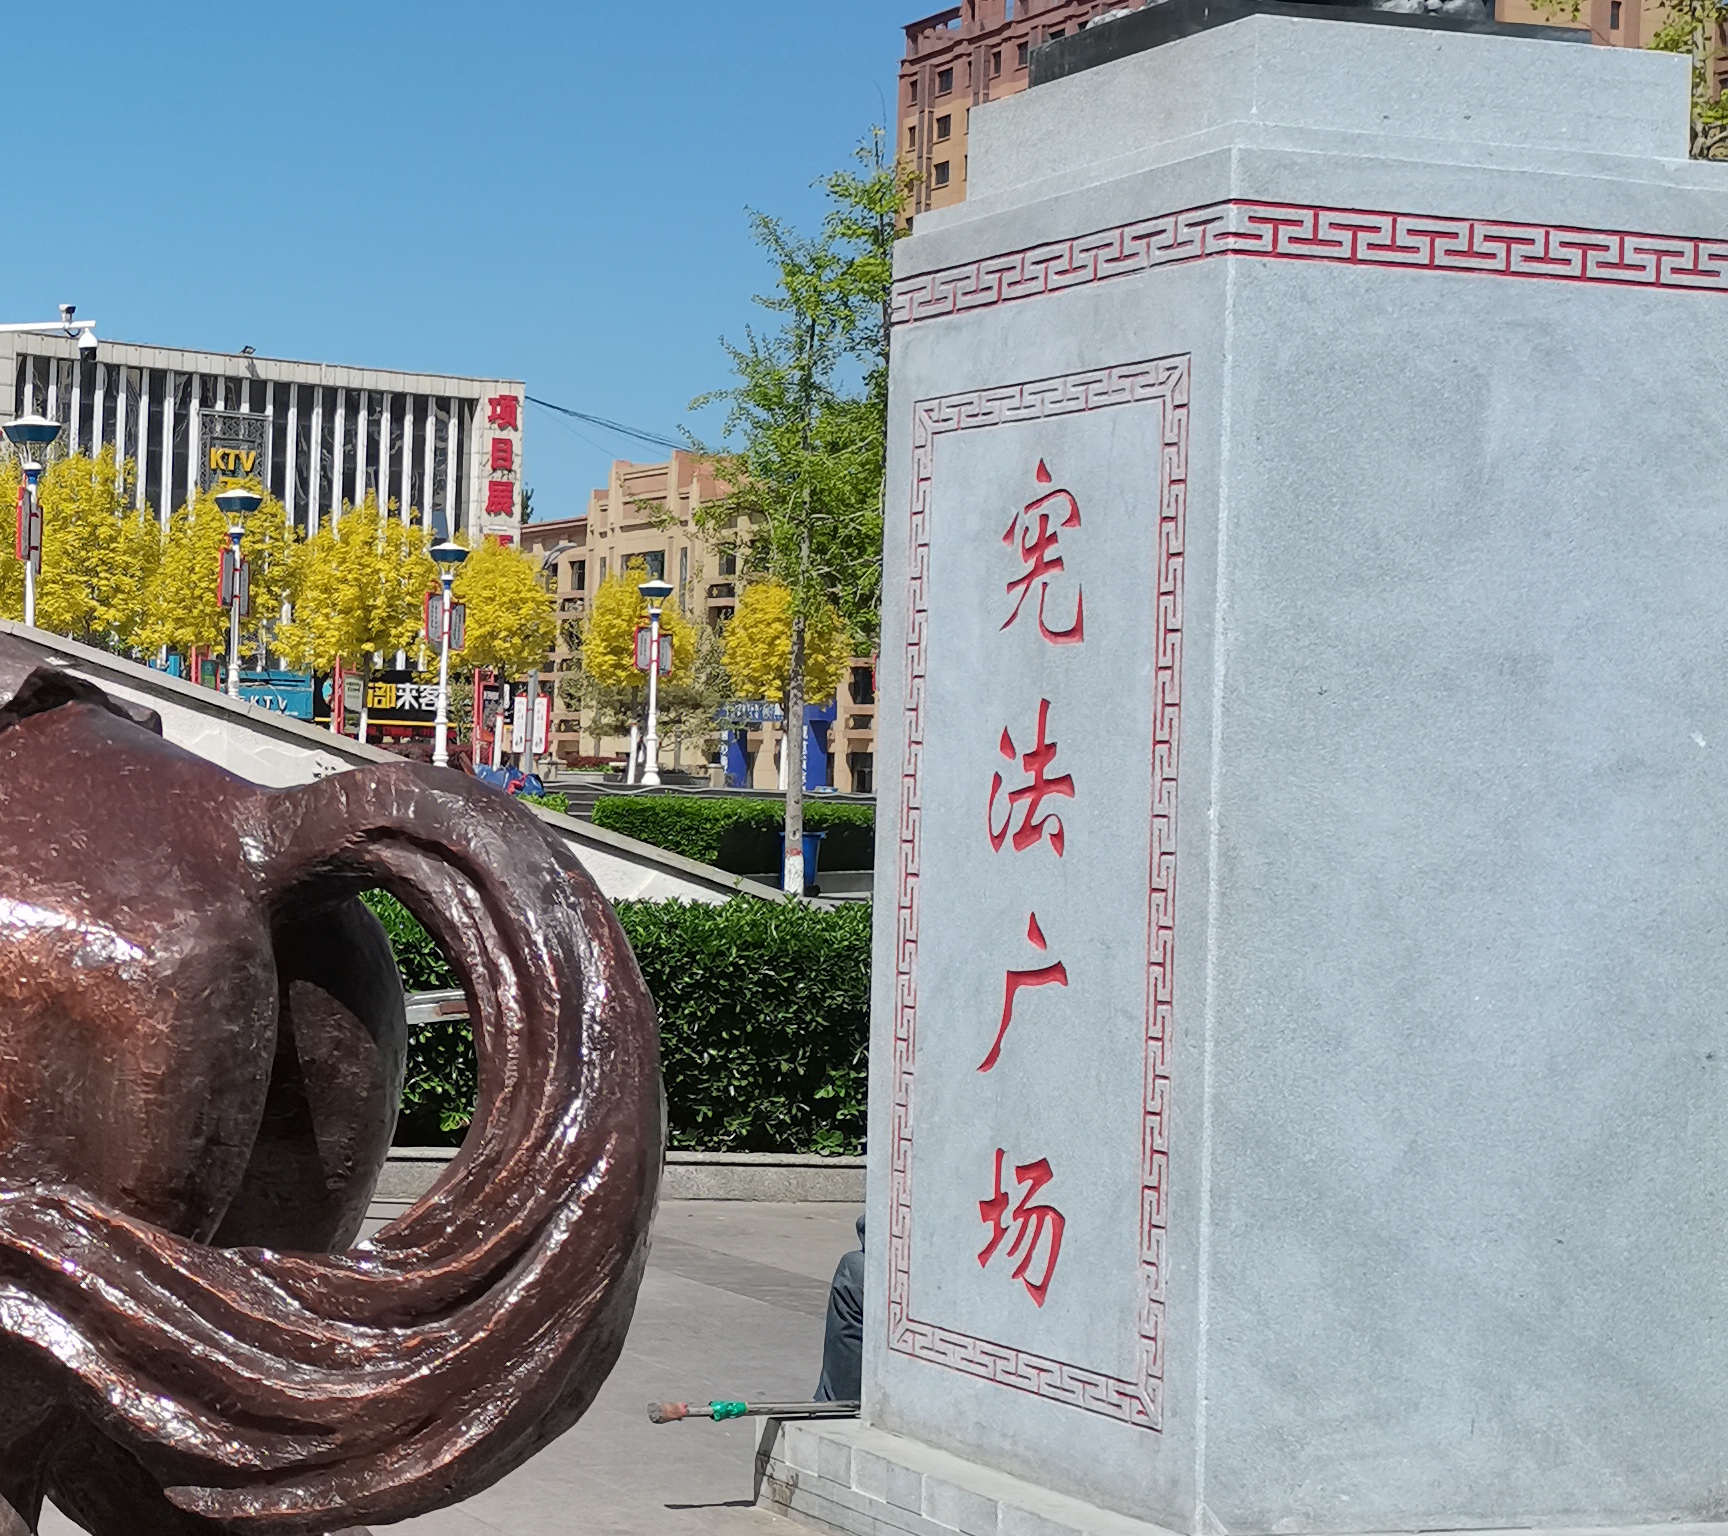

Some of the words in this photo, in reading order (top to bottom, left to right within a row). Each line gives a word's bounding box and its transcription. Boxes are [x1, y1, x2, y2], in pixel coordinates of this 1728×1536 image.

[210, 447, 256, 473] KTV
[485, 394, 519, 547] 项目展
[976, 457, 1084, 1308] 宪法广场
